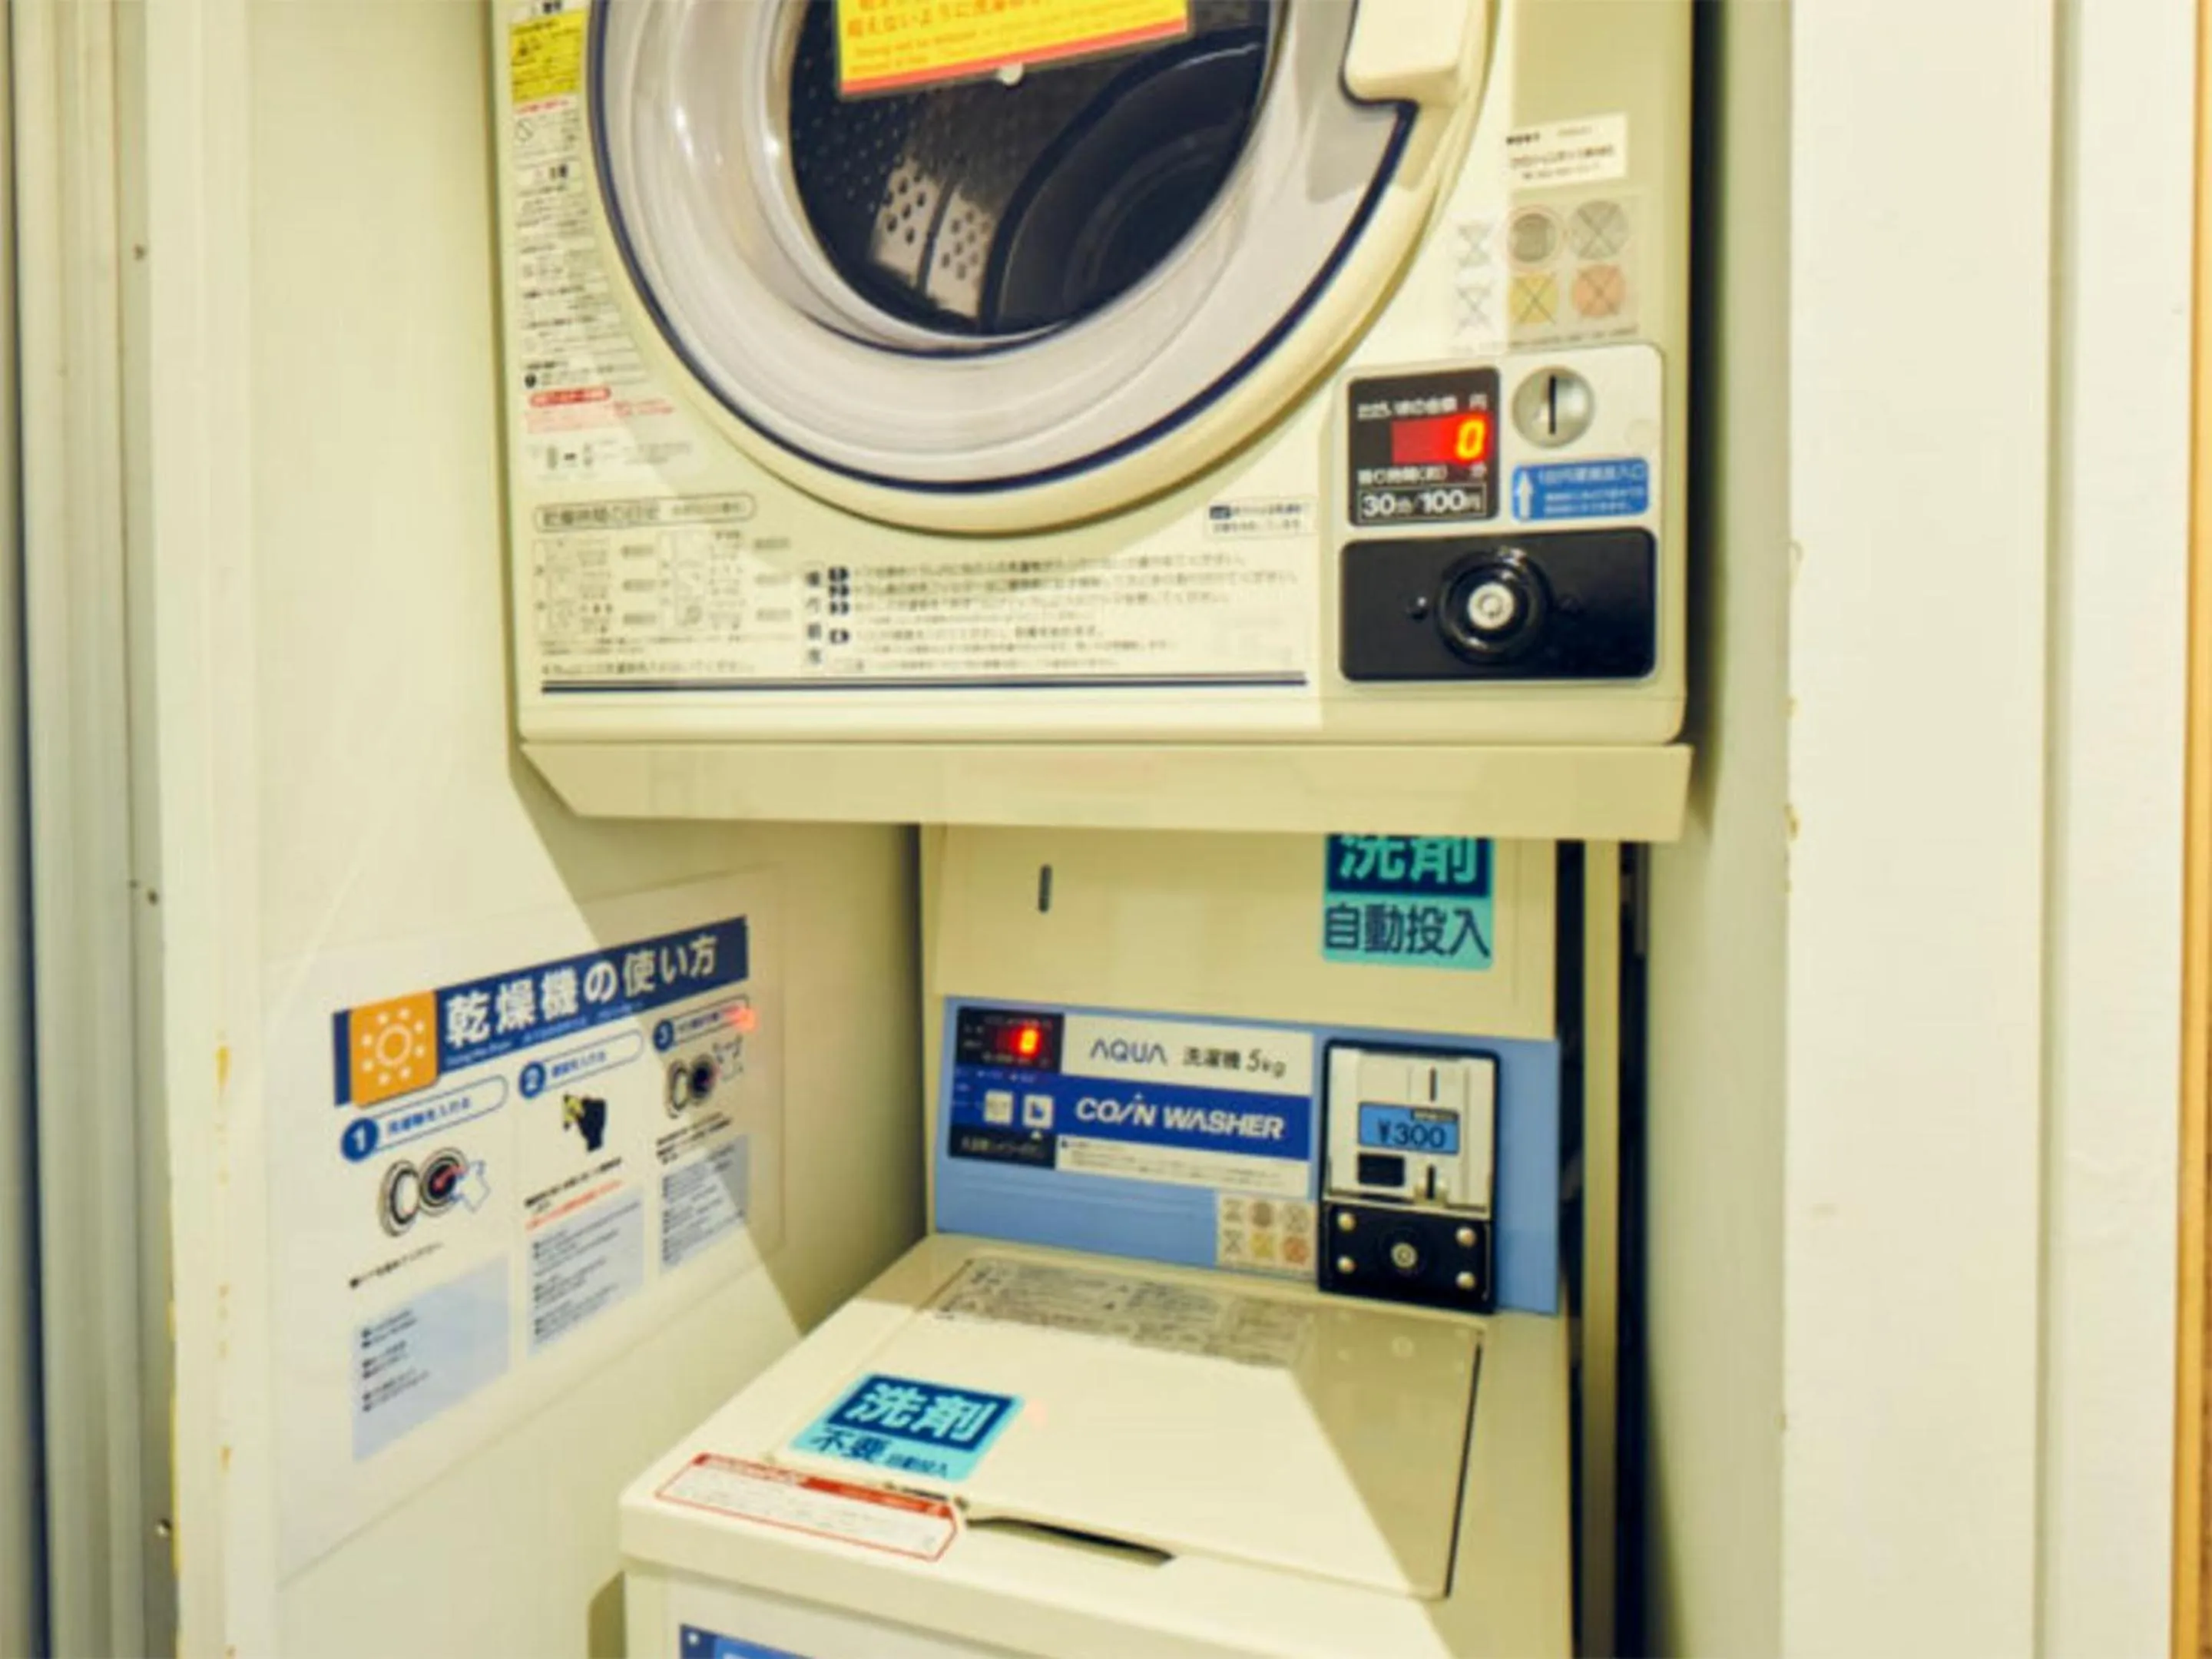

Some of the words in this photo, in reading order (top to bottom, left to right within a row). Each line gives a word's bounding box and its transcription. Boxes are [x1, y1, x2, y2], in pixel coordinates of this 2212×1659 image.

[1456, 419, 1485, 460] 0
[1324, 902, 1491, 958] 自動投入
[443, 933, 718, 1048] 乾燥機の使い方
[1089, 1038, 1168, 1065] AQUA
[1162, 1104, 1286, 1141] WASHER
[1377, 1116, 1446, 1149] ¥300
[844, 1382, 998, 1442] 洗剤
[808, 1425, 892, 1462] 不要
